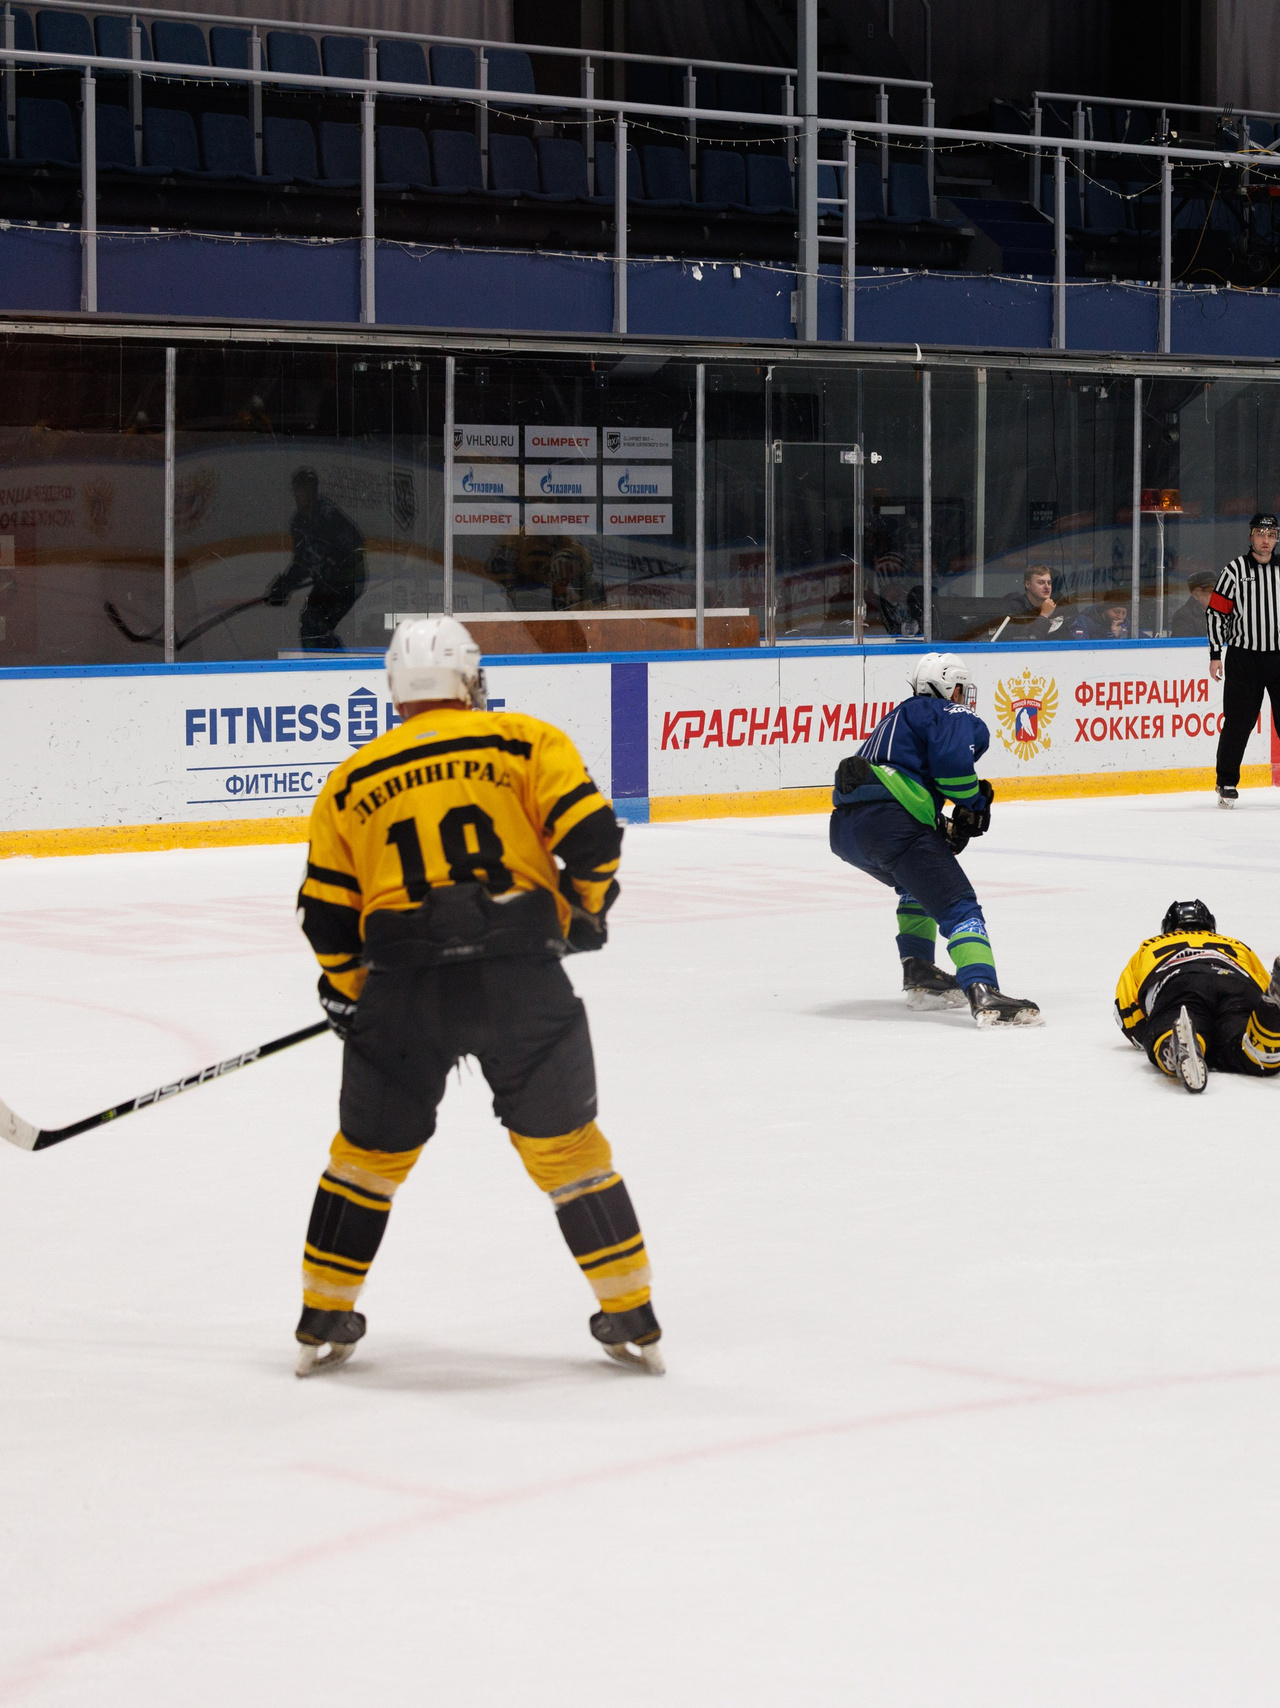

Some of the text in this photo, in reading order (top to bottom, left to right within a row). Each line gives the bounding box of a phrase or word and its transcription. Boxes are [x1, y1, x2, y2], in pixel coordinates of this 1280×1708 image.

[466, 435, 514, 447] VHLRU.RU
[531, 437, 590, 447] OLIMPBET
[474, 482, 504, 494] ГАЗПРОМ
[552, 483, 582, 494] ГАЗПРОМ
[629, 484, 658, 495] ГАЗПРОМ
[454, 514, 513, 524] OLIMPBET
[531, 515, 590, 524] OLIMPBET
[609, 515, 666, 524] OLIMPBET
[1074, 678, 1209, 711] ФЕДЕРАЦИЯ
[185, 703, 341, 746] FITNESS
[660, 705, 813, 750] КРАСНАЯ
[1074, 710, 1262, 743] ХОККЕЯ РОСС
[225, 771, 313, 795] ФИТНЕС
[385, 804, 516, 903] 18
[131, 1046, 262, 1111] FISCHER
